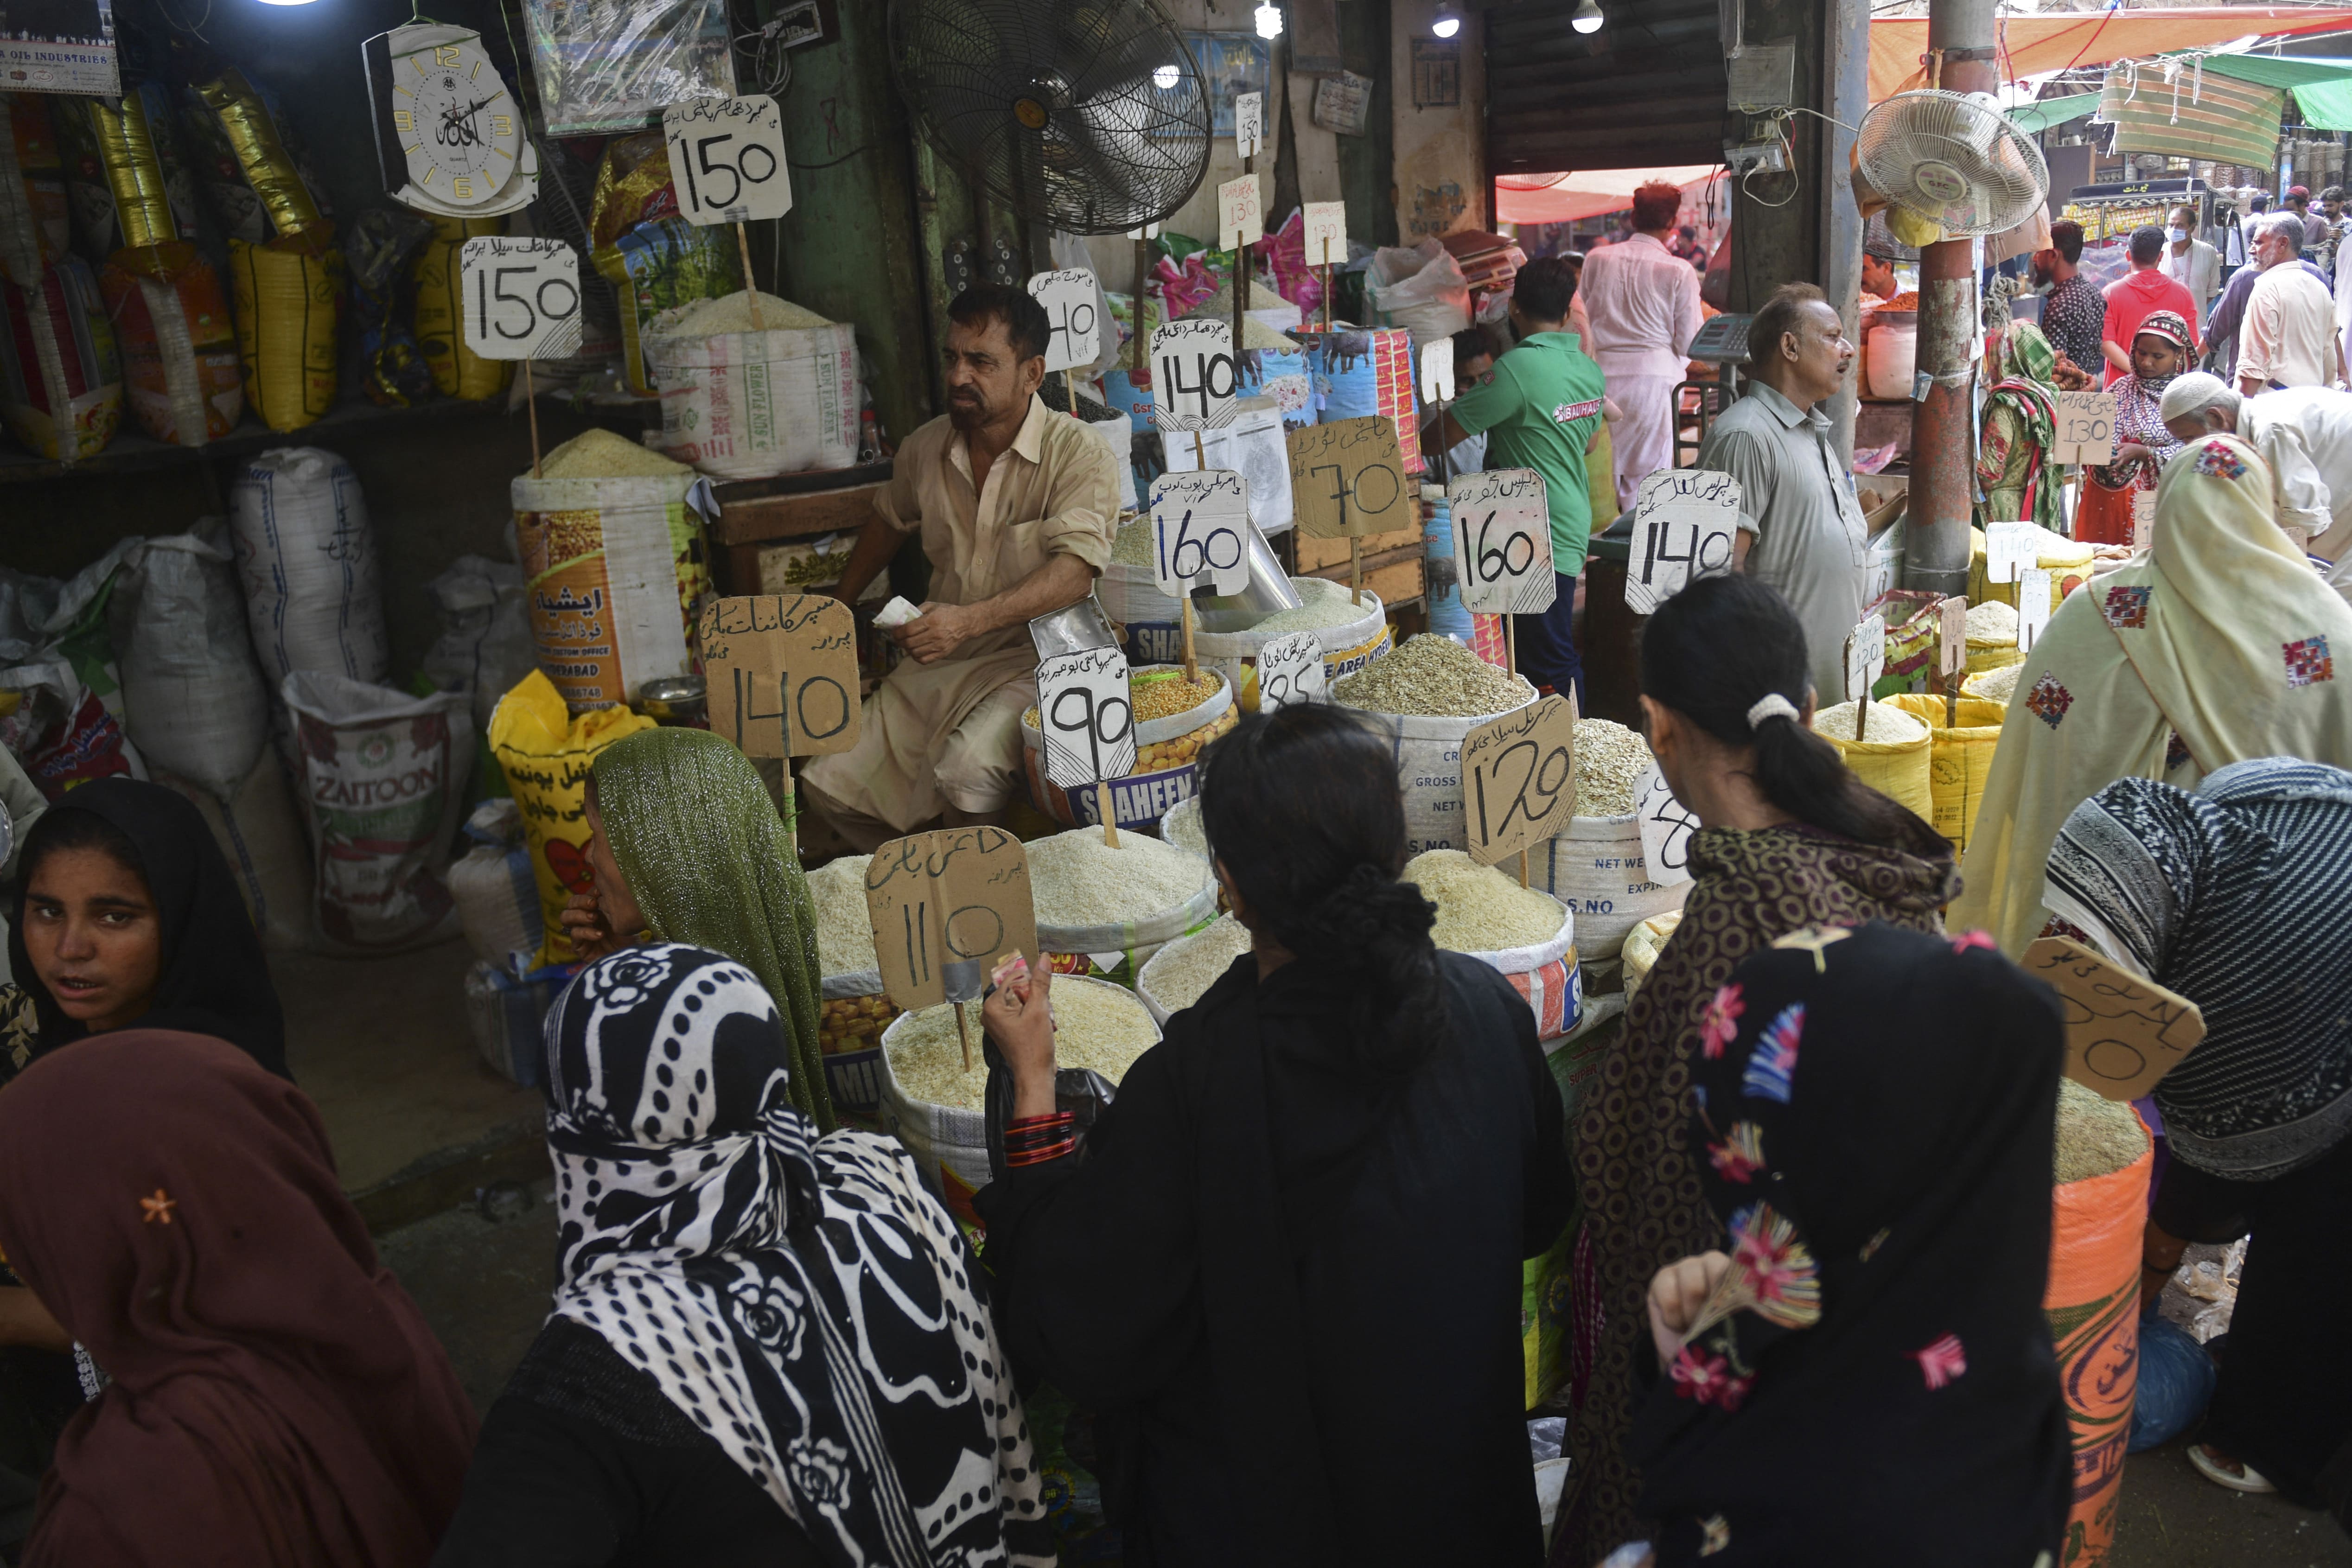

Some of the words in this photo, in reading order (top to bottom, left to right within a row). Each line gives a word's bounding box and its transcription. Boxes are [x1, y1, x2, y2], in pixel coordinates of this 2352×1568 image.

[10, 51, 31, 60] OIL
[35, 52, 107, 64] INDUSTRIES
[433, 46, 461, 68] 12
[681, 133, 777, 212] 150
[478, 266, 579, 340] 150
[749, 364, 766, 411] FLOWER
[820, 362, 833, 386] SUN
[1162, 352, 1236, 419] 140
[754, 417, 769, 437] SUN
[822, 389, 835, 434] FLOWER
[2063, 419, 2108, 443] 130
[1310, 464, 1399, 525] 70
[1158, 509, 1241, 581] 160
[1461, 510, 1534, 587] 160
[1641, 521, 1731, 586] 140
[553, 647, 579, 657] CUSTOM
[581, 646, 610, 656] OFFICE
[1337, 655, 1366, 676] AREA
[1855, 643, 1878, 675] 120
[733, 668, 850, 758] 140
[1050, 686, 1133, 783] 90
[316, 761, 438, 805] ZAITOON
[1080, 773, 1192, 825] SAHEEN
[1415, 777, 1456, 787] GROSS
[1474, 739, 1570, 847] 120
[1433, 802, 1456, 811] NET
[1409, 840, 1450, 853] S.NO
[1595, 859, 1620, 869] NET
[1568, 899, 1613, 914] S.NO
[903, 901, 1004, 987] 110
[1053, 965, 1064, 974] KG
[1569, 1063, 1598, 1087] SUPER
